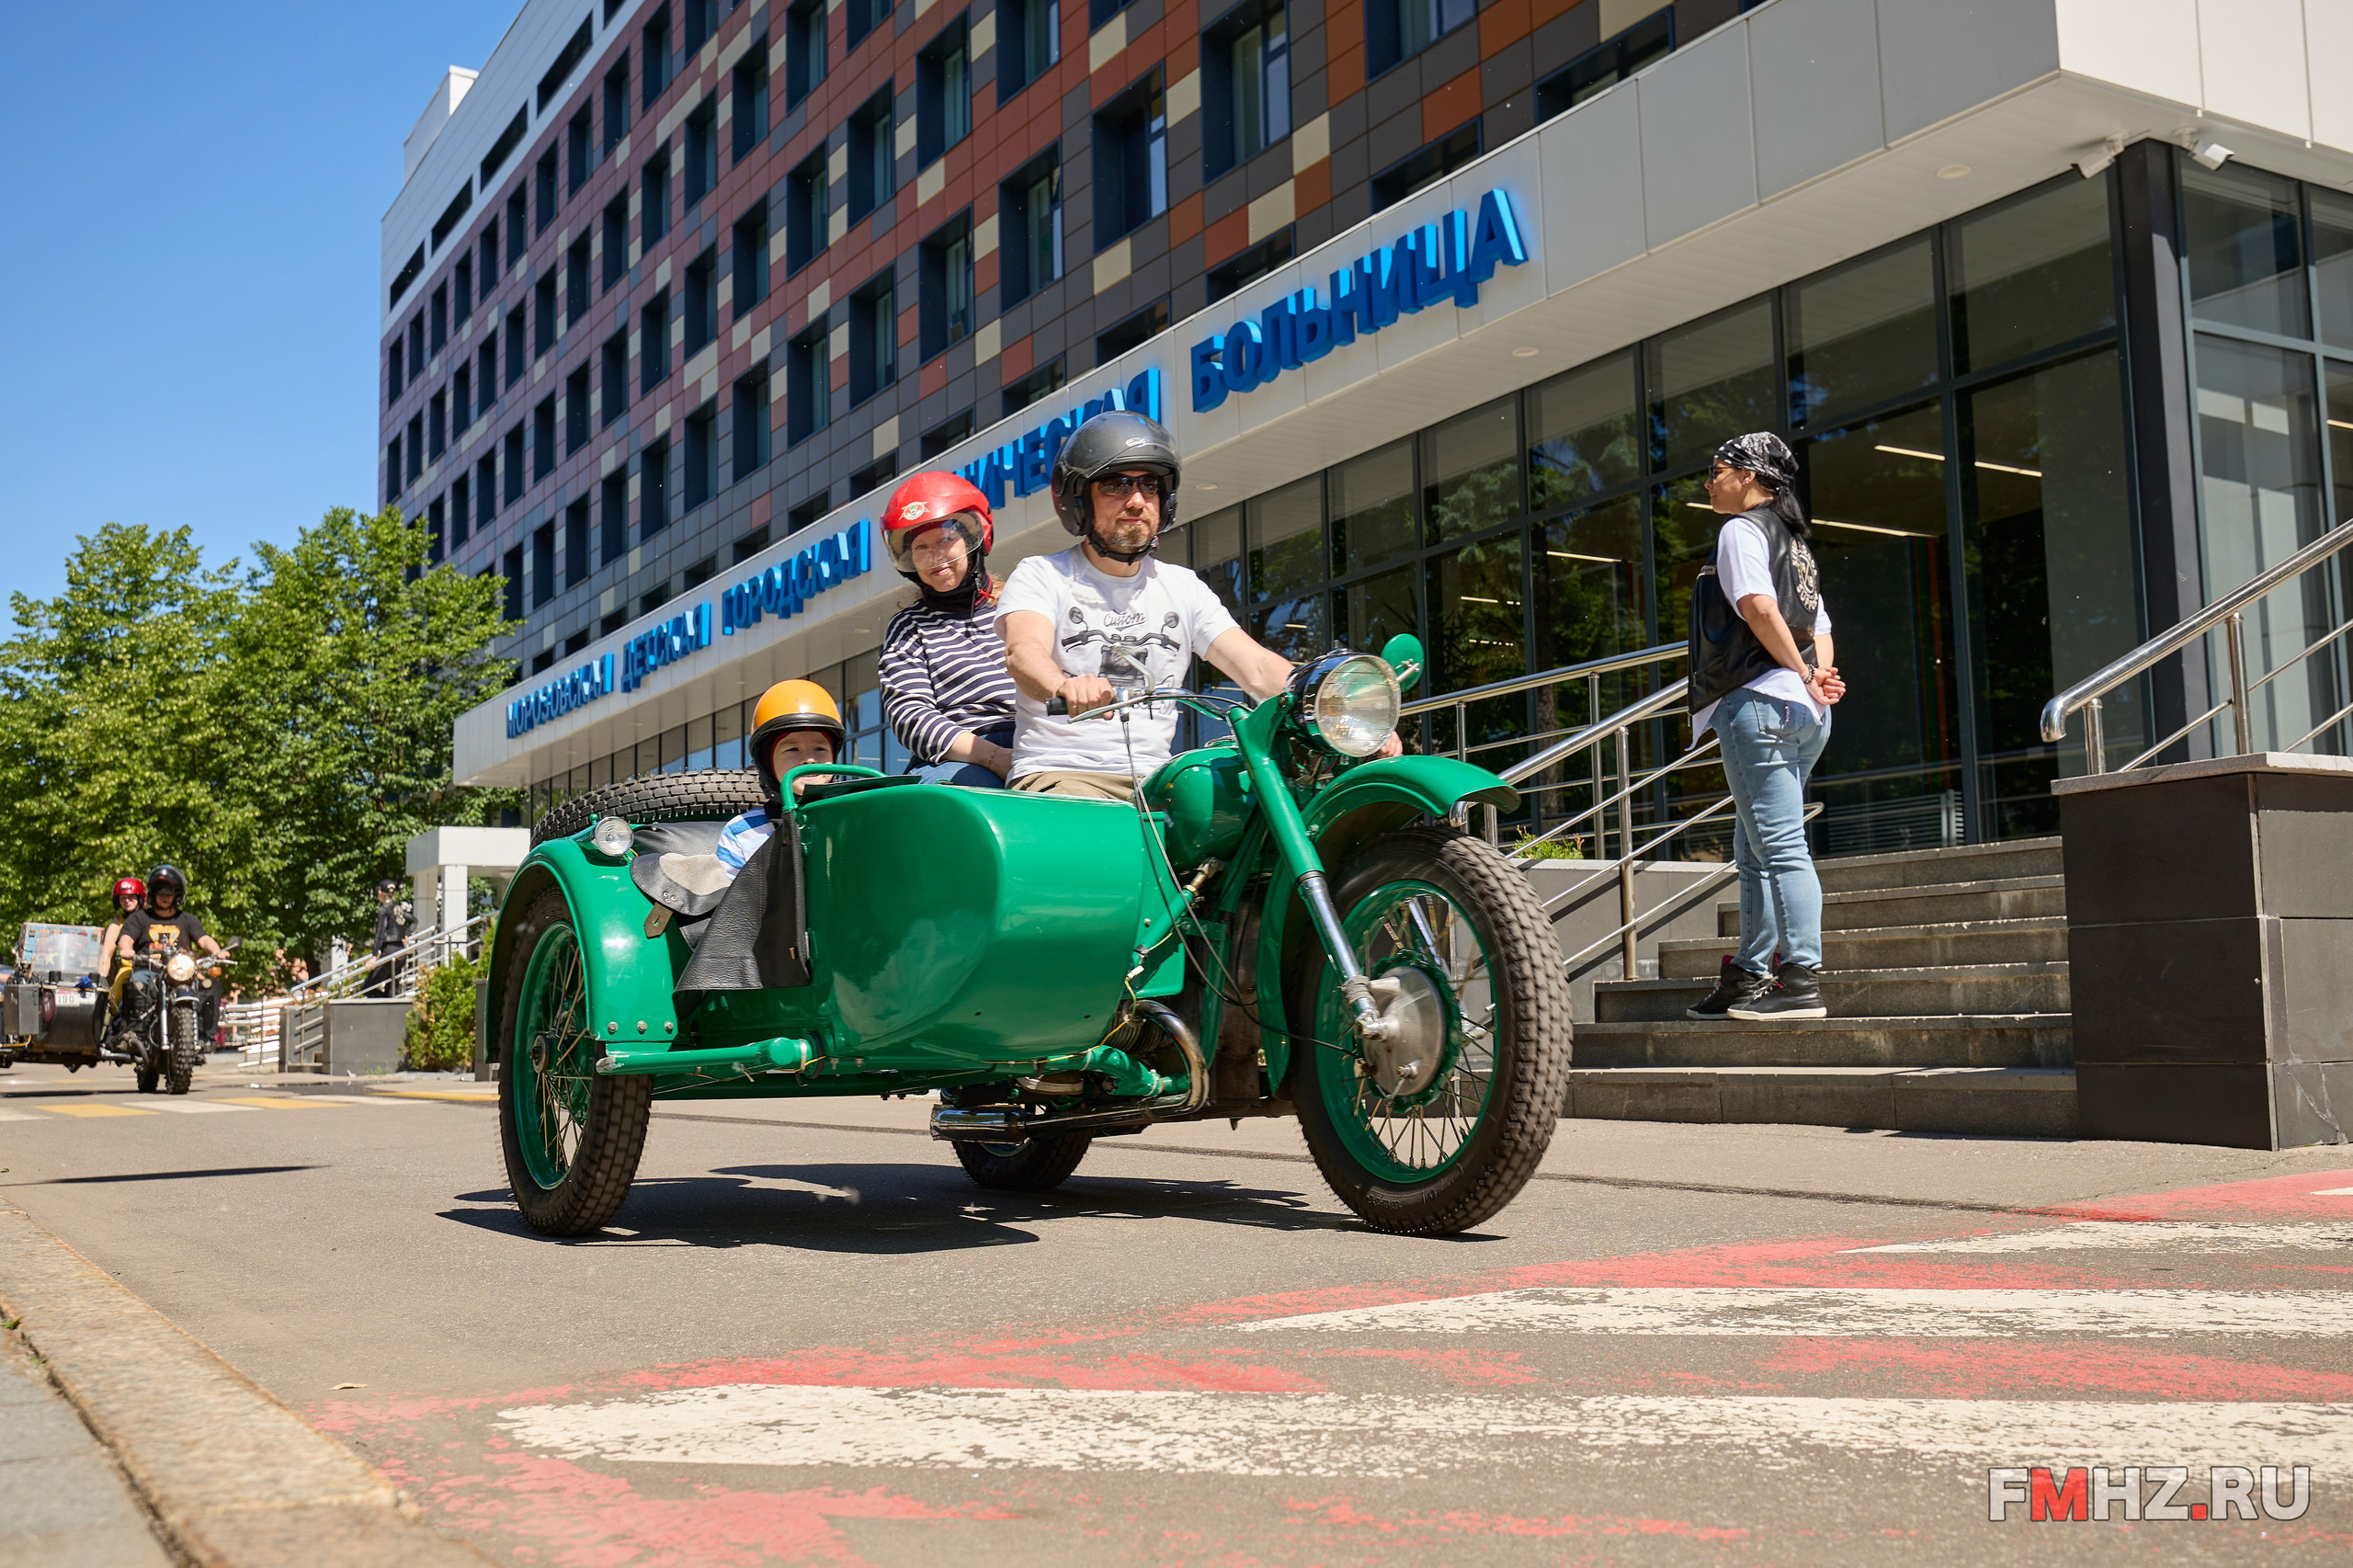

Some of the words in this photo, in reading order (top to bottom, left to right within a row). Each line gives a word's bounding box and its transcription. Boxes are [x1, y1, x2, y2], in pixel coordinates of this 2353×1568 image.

[506, 653, 614, 739] МОРОЗОВСКАЯ
[620, 602, 711, 693] ДЕТСКАЯ
[722, 520, 871, 636] ГОРОДСКАЯ
[1190, 188, 1529, 414] БОЛЬНИЦА
